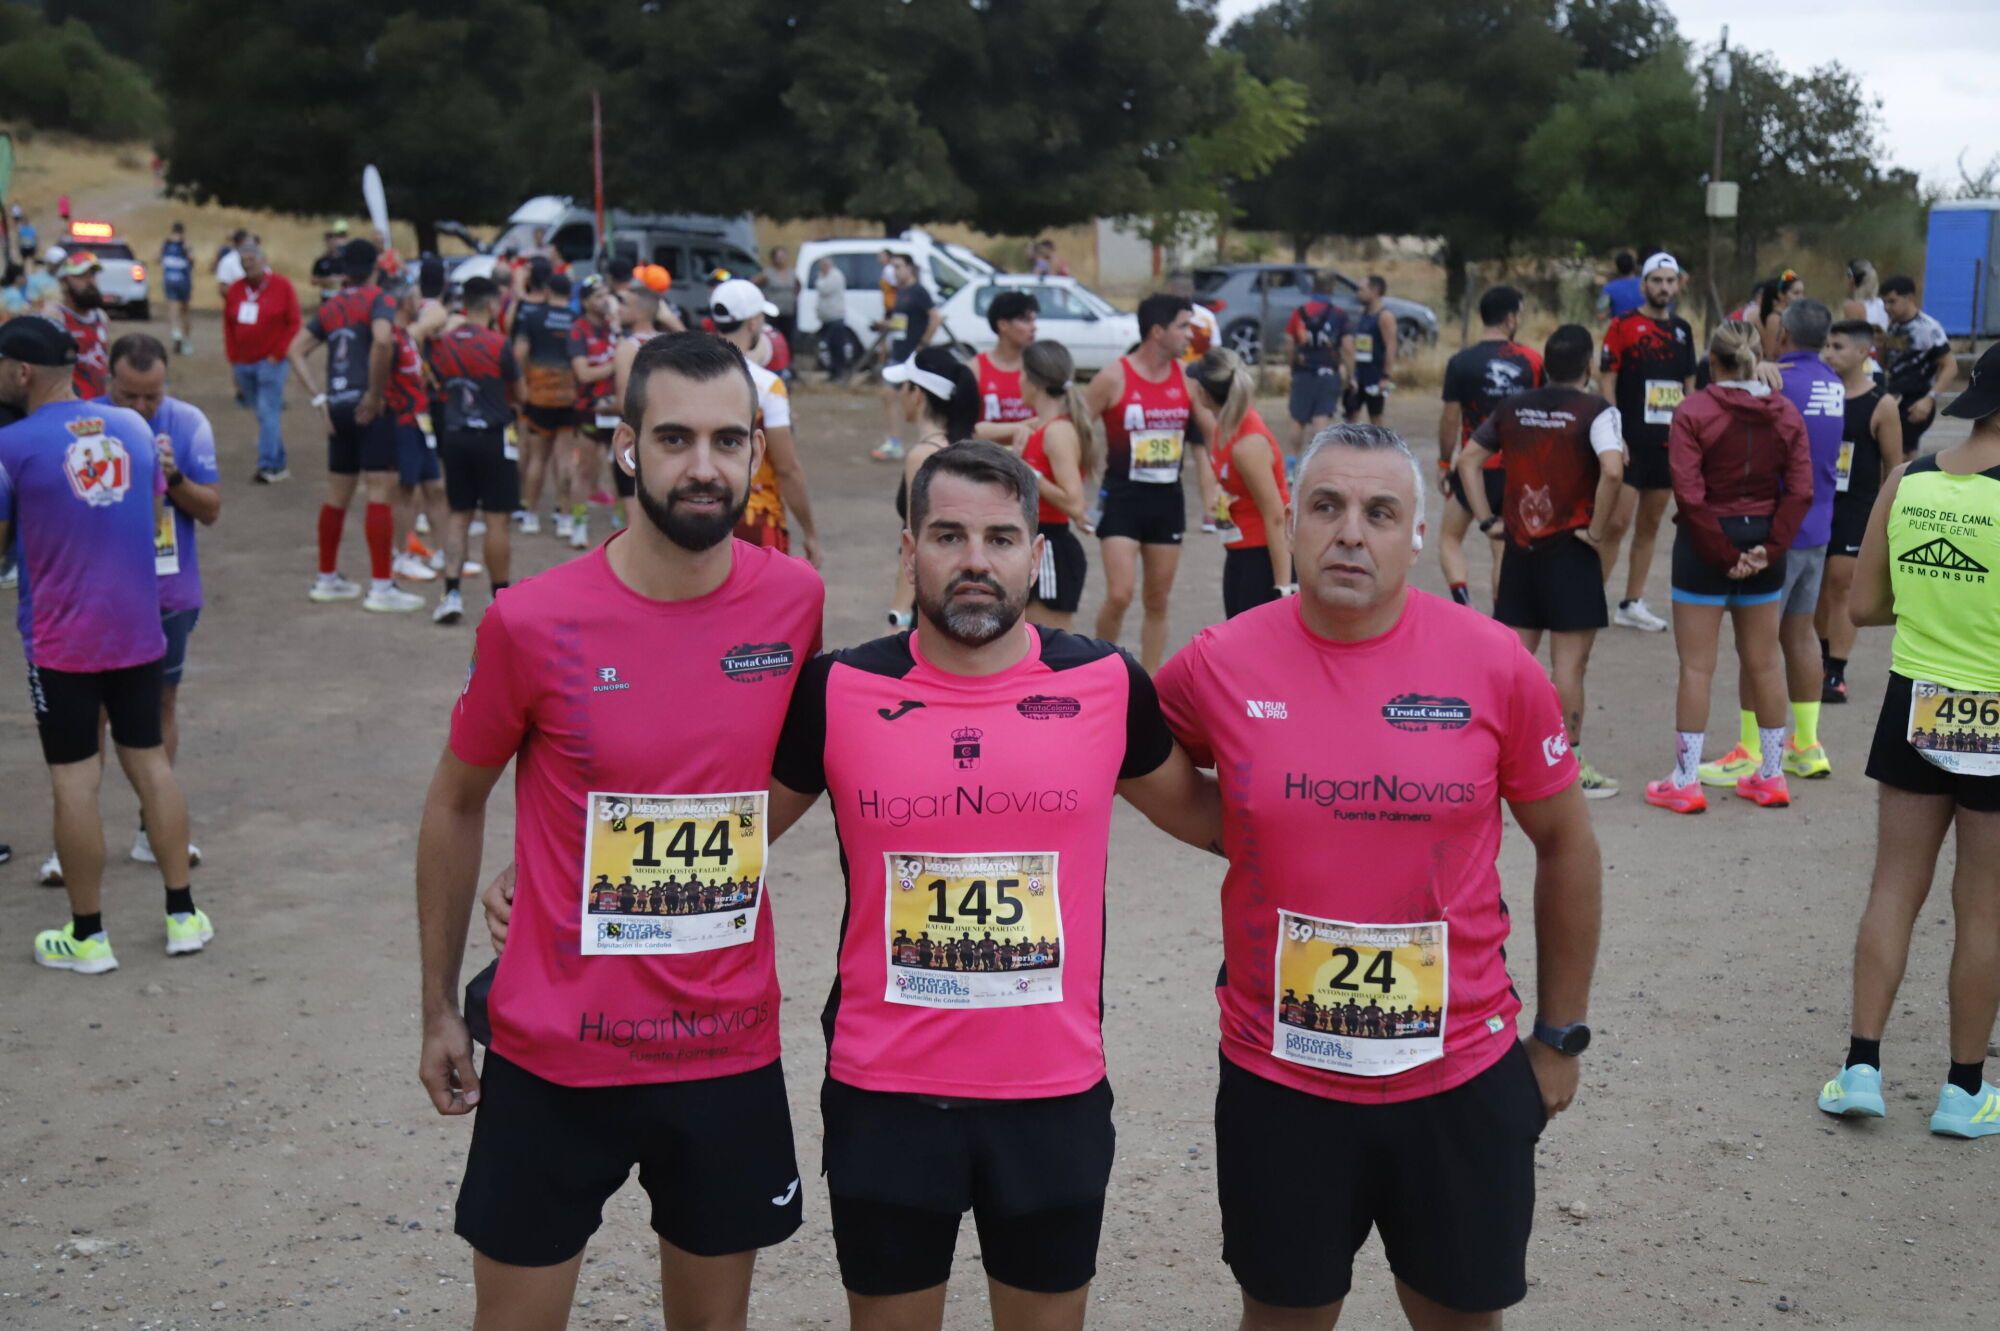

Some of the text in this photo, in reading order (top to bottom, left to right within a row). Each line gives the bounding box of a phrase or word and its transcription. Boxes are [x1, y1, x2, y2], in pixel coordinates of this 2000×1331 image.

[1901, 506, 1994, 526] AMIGOS DEL CANAL
[1909, 519, 1978, 537] PUENTE GENIL
[1900, 564, 1985, 583] ESMONSUR
[726, 654, 788, 670] TrotaColonia
[1919, 686, 1937, 698] 39
[1264, 701, 1286, 711] RUN
[1388, 706, 1464, 718] TrotaColonia
[1936, 697, 2000, 726] 496
[1266, 710, 1288, 720] PRO
[1285, 773, 1475, 807] HigarNovias
[632, 804, 670, 813] MEDIA
[859, 785, 1078, 827] HigarNovias
[1334, 809, 1432, 822] Fuente Palmera
[633, 820, 733, 867] 144
[896, 859, 923, 879] 39
[925, 862, 960, 872] MEDIA
[928, 879, 1023, 925] 145
[598, 923, 661, 932] creras
[1287, 922, 1314, 943] 39
[1315, 928, 1350, 940] MEDIA
[1329, 947, 1396, 993] 24
[901, 974, 958, 987] arreras
[578, 1001, 768, 1047] HigarNovias
[1286, 1033, 1342, 1050] carreras
[1286, 1039, 1353, 1060] populares
[630, 1051, 673, 1062] Fuente
